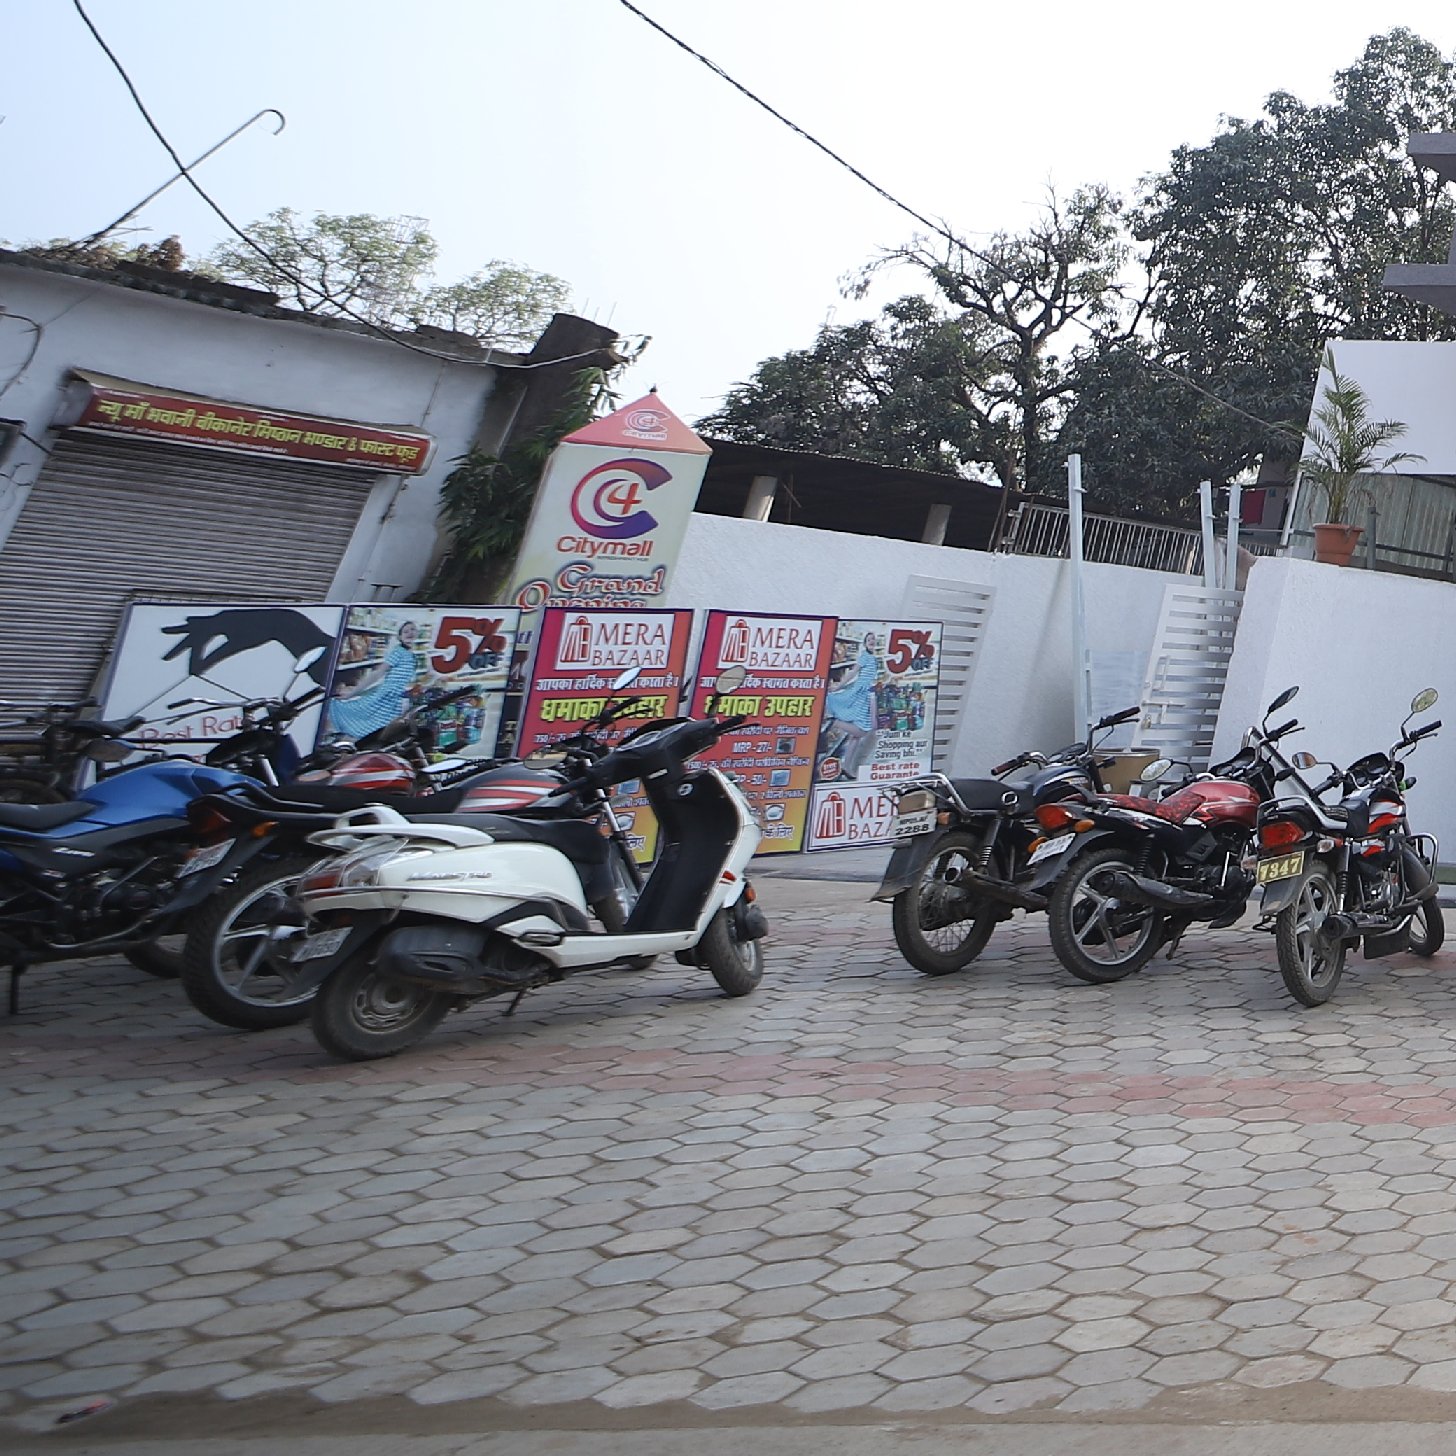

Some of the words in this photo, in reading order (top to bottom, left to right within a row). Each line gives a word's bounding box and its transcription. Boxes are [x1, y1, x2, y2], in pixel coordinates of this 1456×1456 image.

[557, 536, 653, 558] Citymall
[557, 563, 666, 594] Grand
[595, 622, 667, 646] MERA
[752, 628, 814, 649] MERA
[431, 616, 507, 674] 5%
[886, 629, 935, 673] 5%
[592, 648, 667, 666] BAZAAR
[749, 652, 812, 668] BAZAAR
[764, 696, 815, 717] उपहार
[875, 751, 901, 759] Saving
[878, 741, 913, 749] Shopping
[871, 763, 897, 771] Best
[850, 795, 899, 819] ME
[848, 822, 893, 839] BAZ
